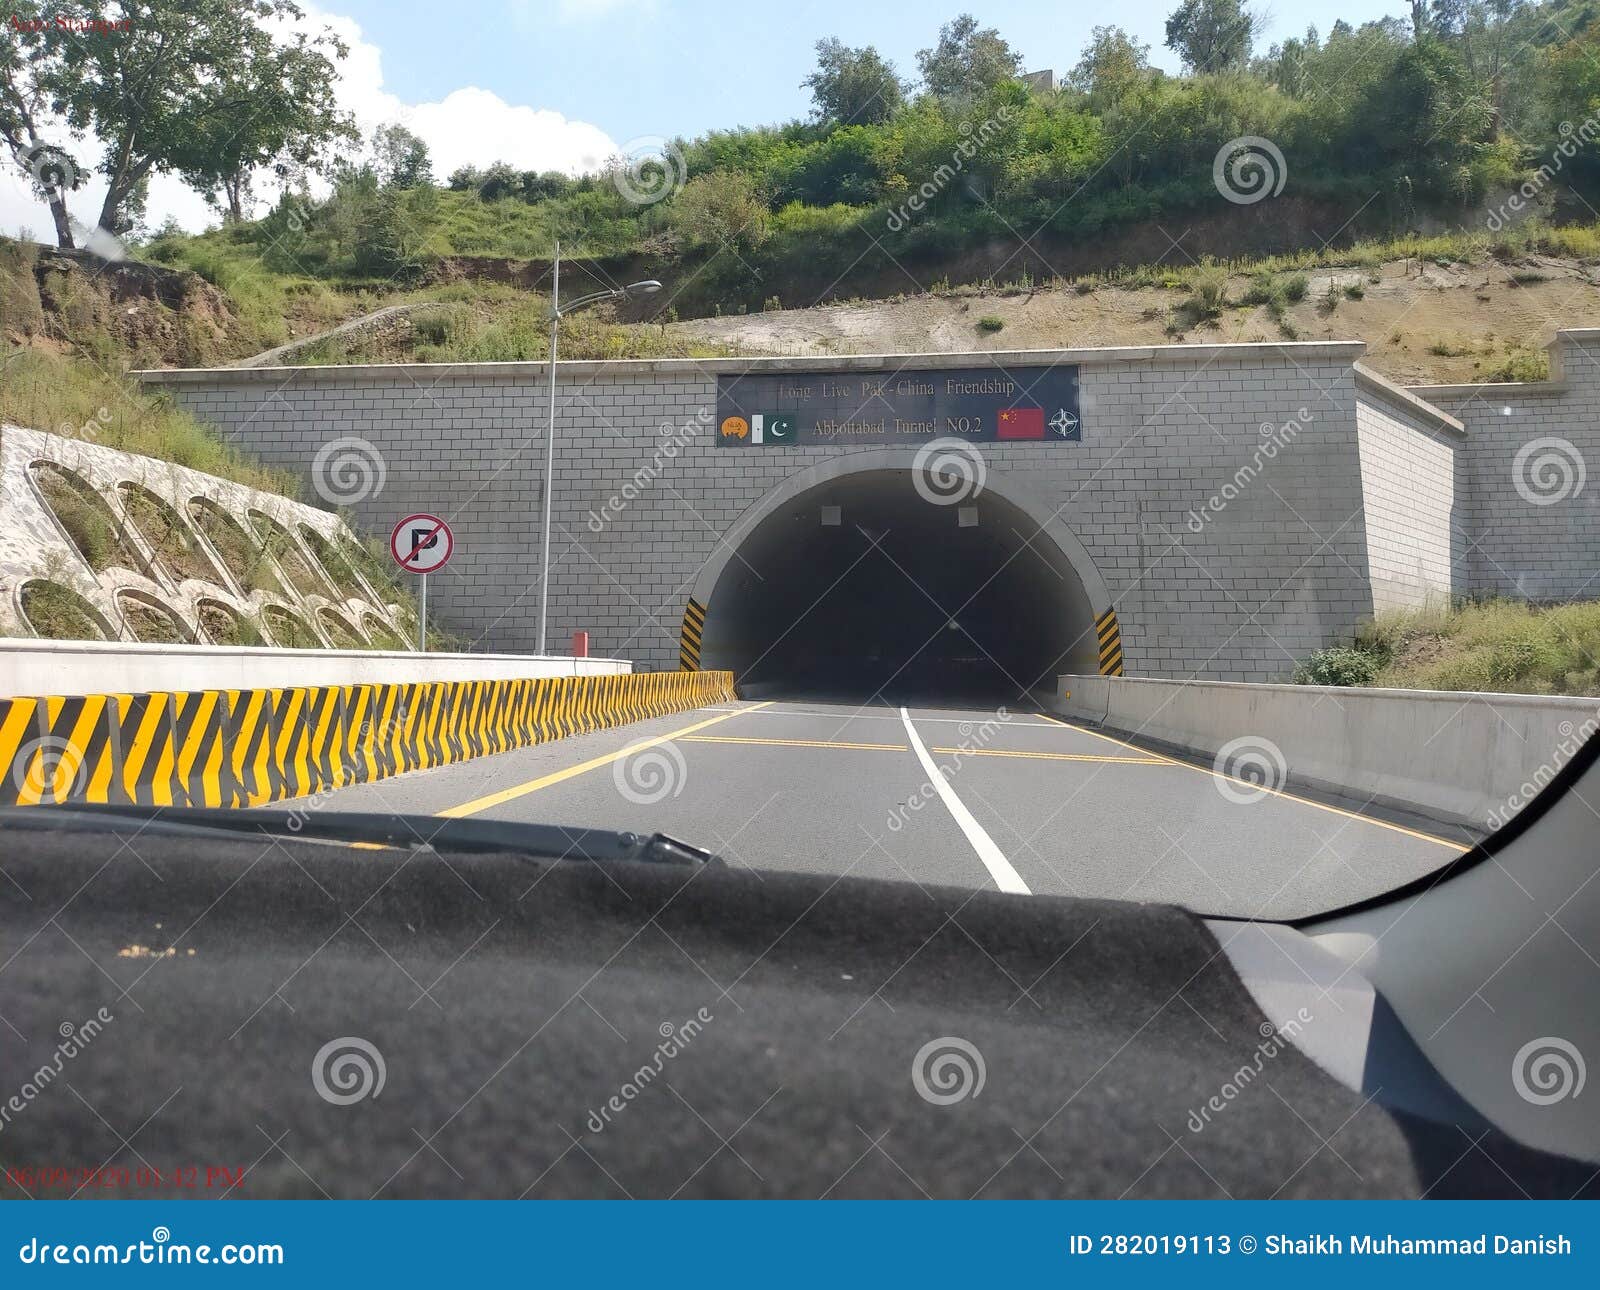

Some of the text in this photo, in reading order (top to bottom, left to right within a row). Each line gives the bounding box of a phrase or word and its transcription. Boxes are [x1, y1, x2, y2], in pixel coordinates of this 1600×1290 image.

[780, 383, 812, 401] Long
[823, 381, 850, 398] Live
[947, 377, 1015, 398] Friendship
[813, 417, 885, 436] Abbottabad
[946, 416, 983, 433] NO.2
[411, 528, 438, 562] P
